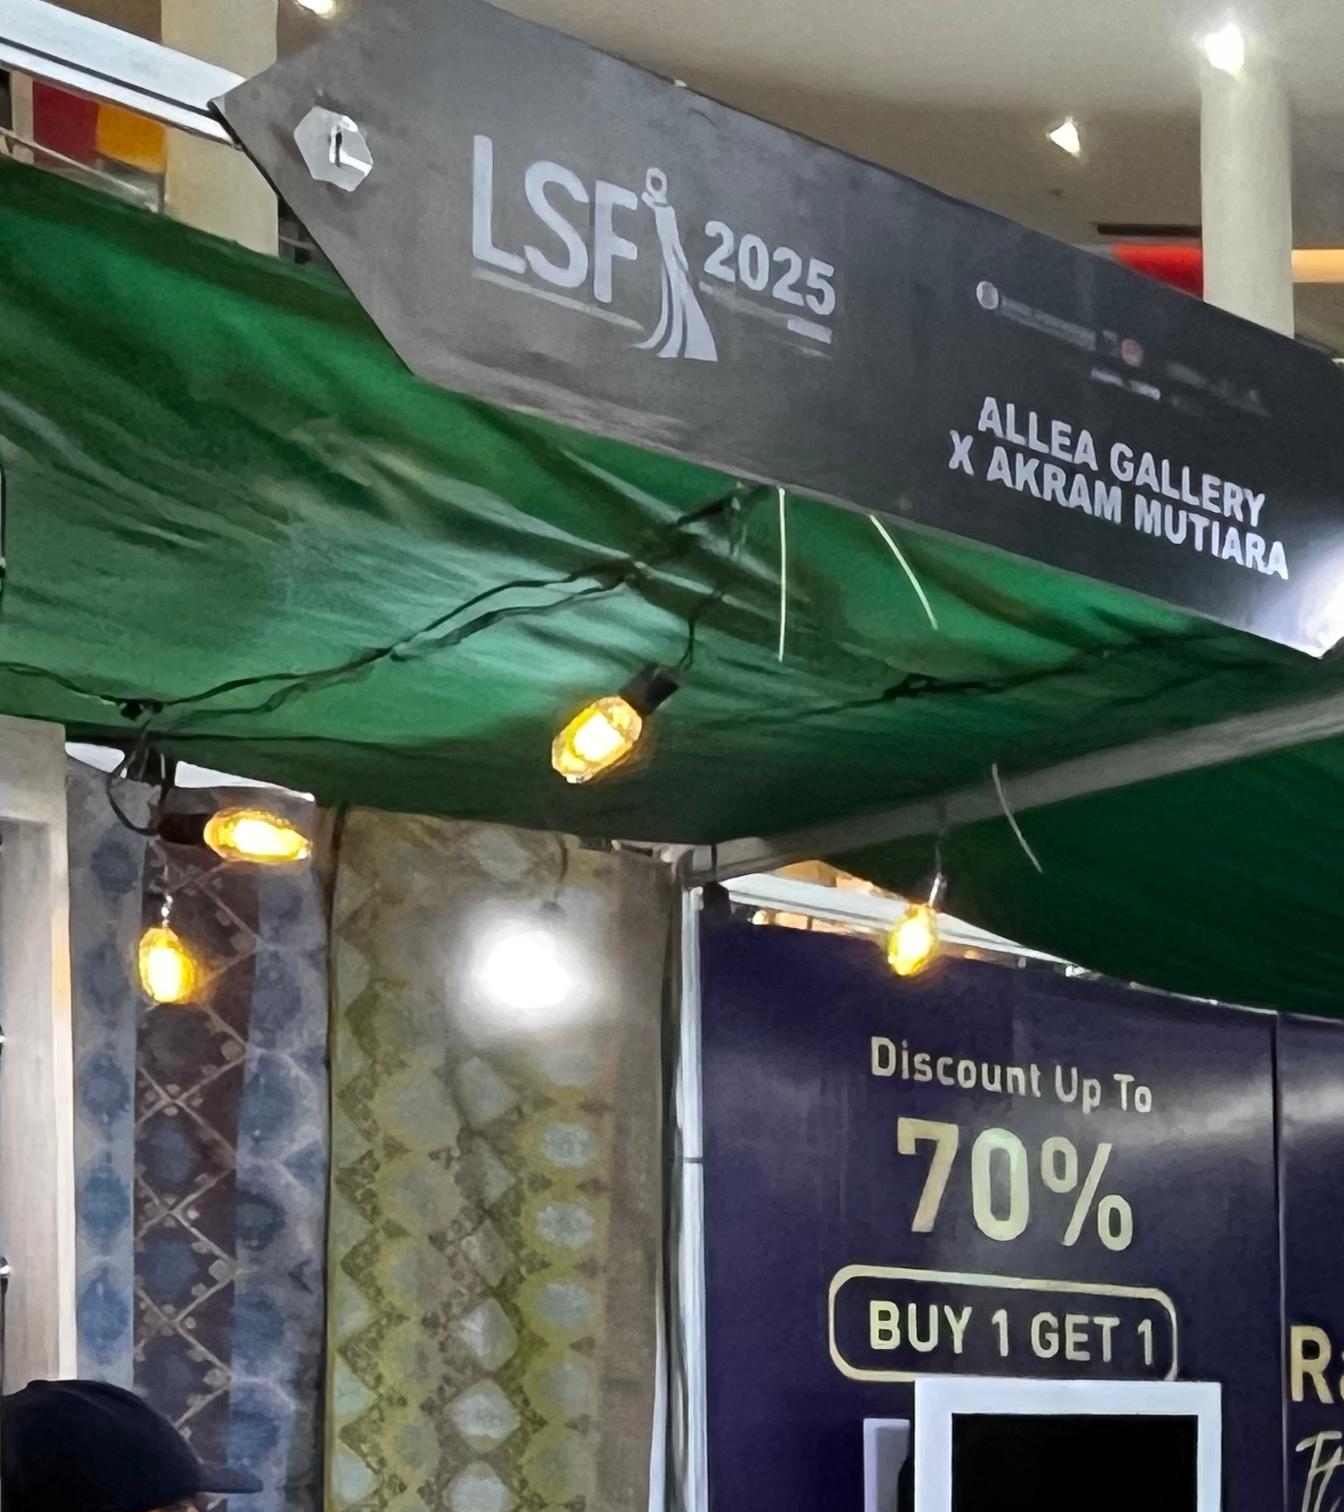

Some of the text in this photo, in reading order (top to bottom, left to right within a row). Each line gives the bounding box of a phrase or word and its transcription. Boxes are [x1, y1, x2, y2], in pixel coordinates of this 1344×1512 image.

[472, 135, 836, 315] LSF 2025
[978, 397, 1265, 527] ALLEA GALLERY
[987, 446, 1122, 524] AKRAM
[1134, 501, 1288, 580] MUTIARA
[870, 1036, 1152, 1114] Discount Up To
[897, 1117, 1133, 1251] 70%
[869, 1300, 1153, 1366] BUY 1 GET 1
